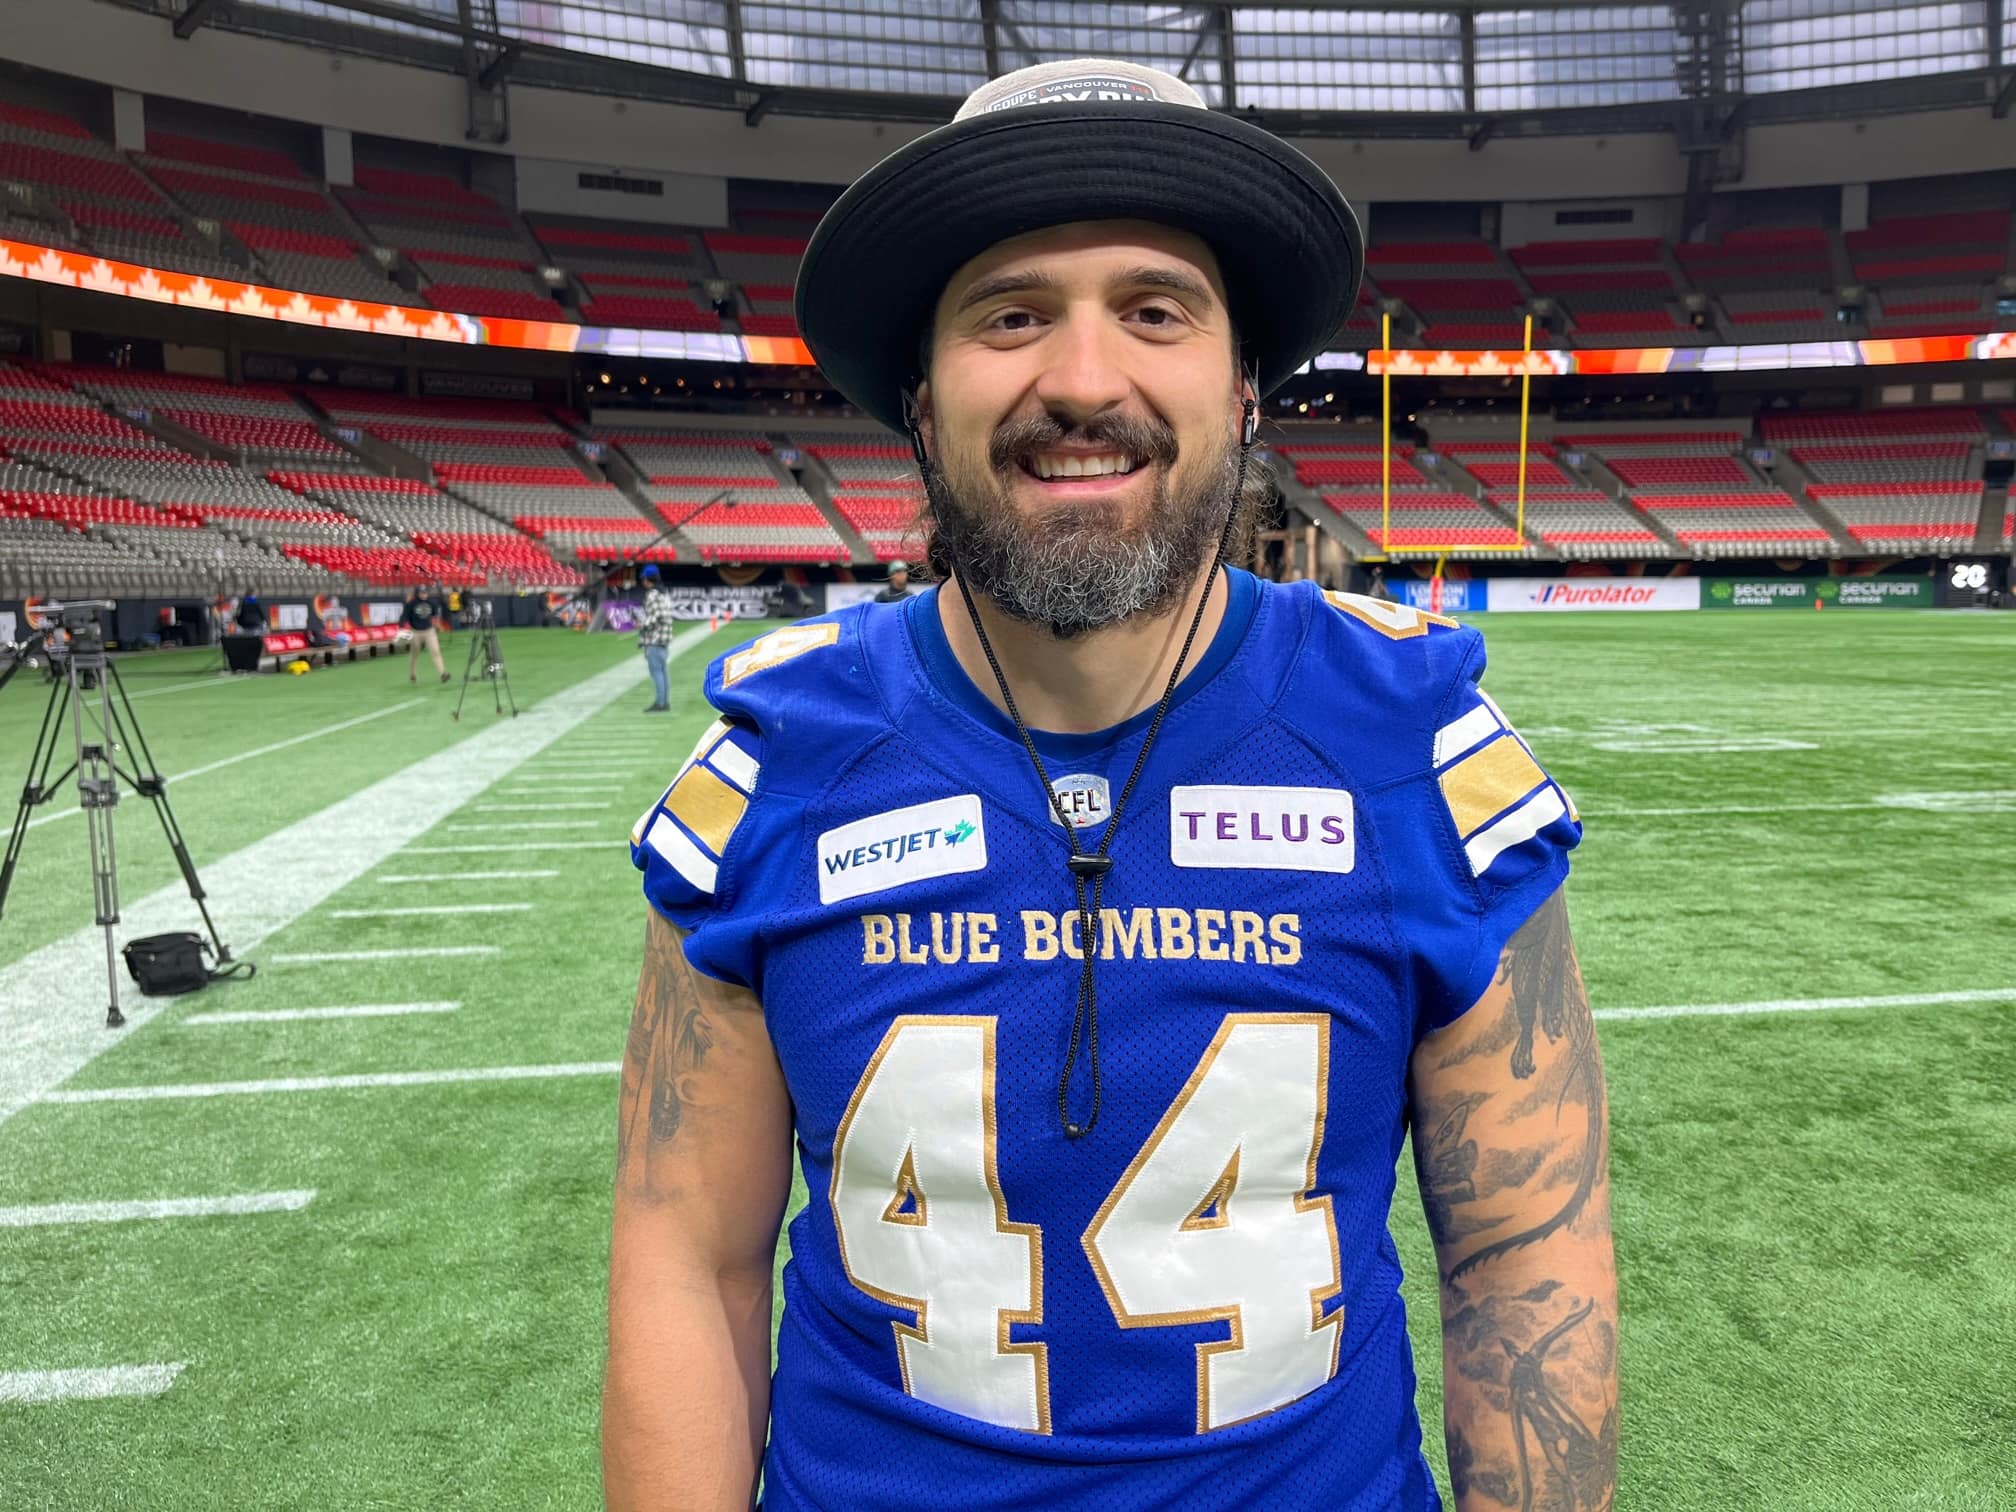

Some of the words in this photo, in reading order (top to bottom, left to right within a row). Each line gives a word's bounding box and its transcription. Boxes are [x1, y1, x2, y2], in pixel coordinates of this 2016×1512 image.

[1045, 80, 1128, 92] VANCOUVER
[993, 90, 1037, 111] COUPE
[668, 586, 776, 599] UPPLEMENT
[1551, 584, 1656, 604] Purolator
[1057, 789, 1101, 814] CFL
[1179, 811, 1346, 845] TELUS
[824, 827, 942, 875] WESTJET
[861, 912, 999, 966] BLUE
[1020, 907, 1303, 967] BOMBERS
[829, 1012, 1345, 1436] 44
